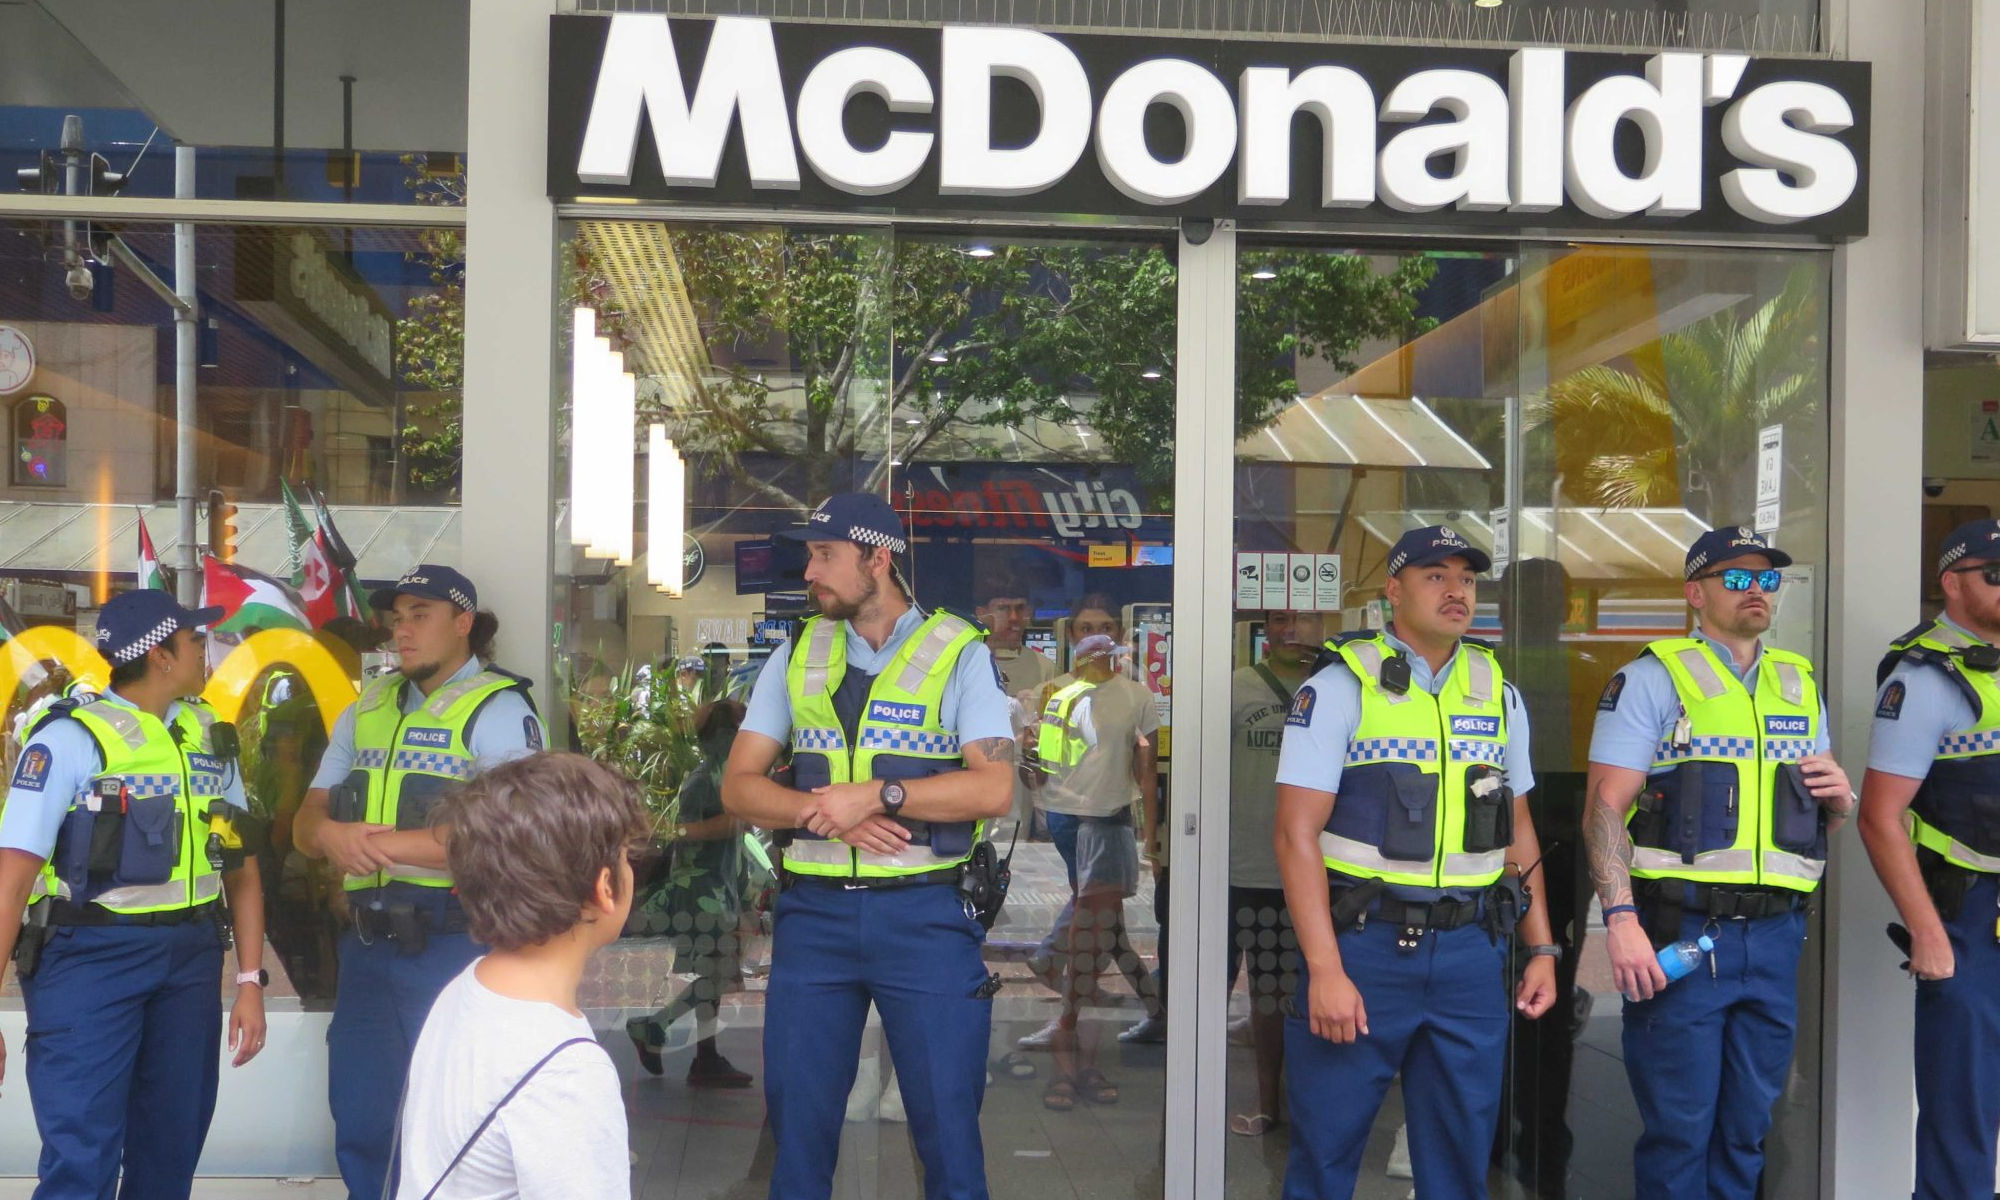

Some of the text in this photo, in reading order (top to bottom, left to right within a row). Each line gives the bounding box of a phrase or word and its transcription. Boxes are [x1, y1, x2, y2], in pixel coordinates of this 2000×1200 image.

[577, 12, 1858, 224] McDonald's
[872, 703, 921, 720] POLICE
[1453, 718, 1496, 732] POLICE
[1768, 720, 1806, 731] POLICE
[407, 730, 447, 743] POLICE
[15, 779, 41, 788] POLICE
